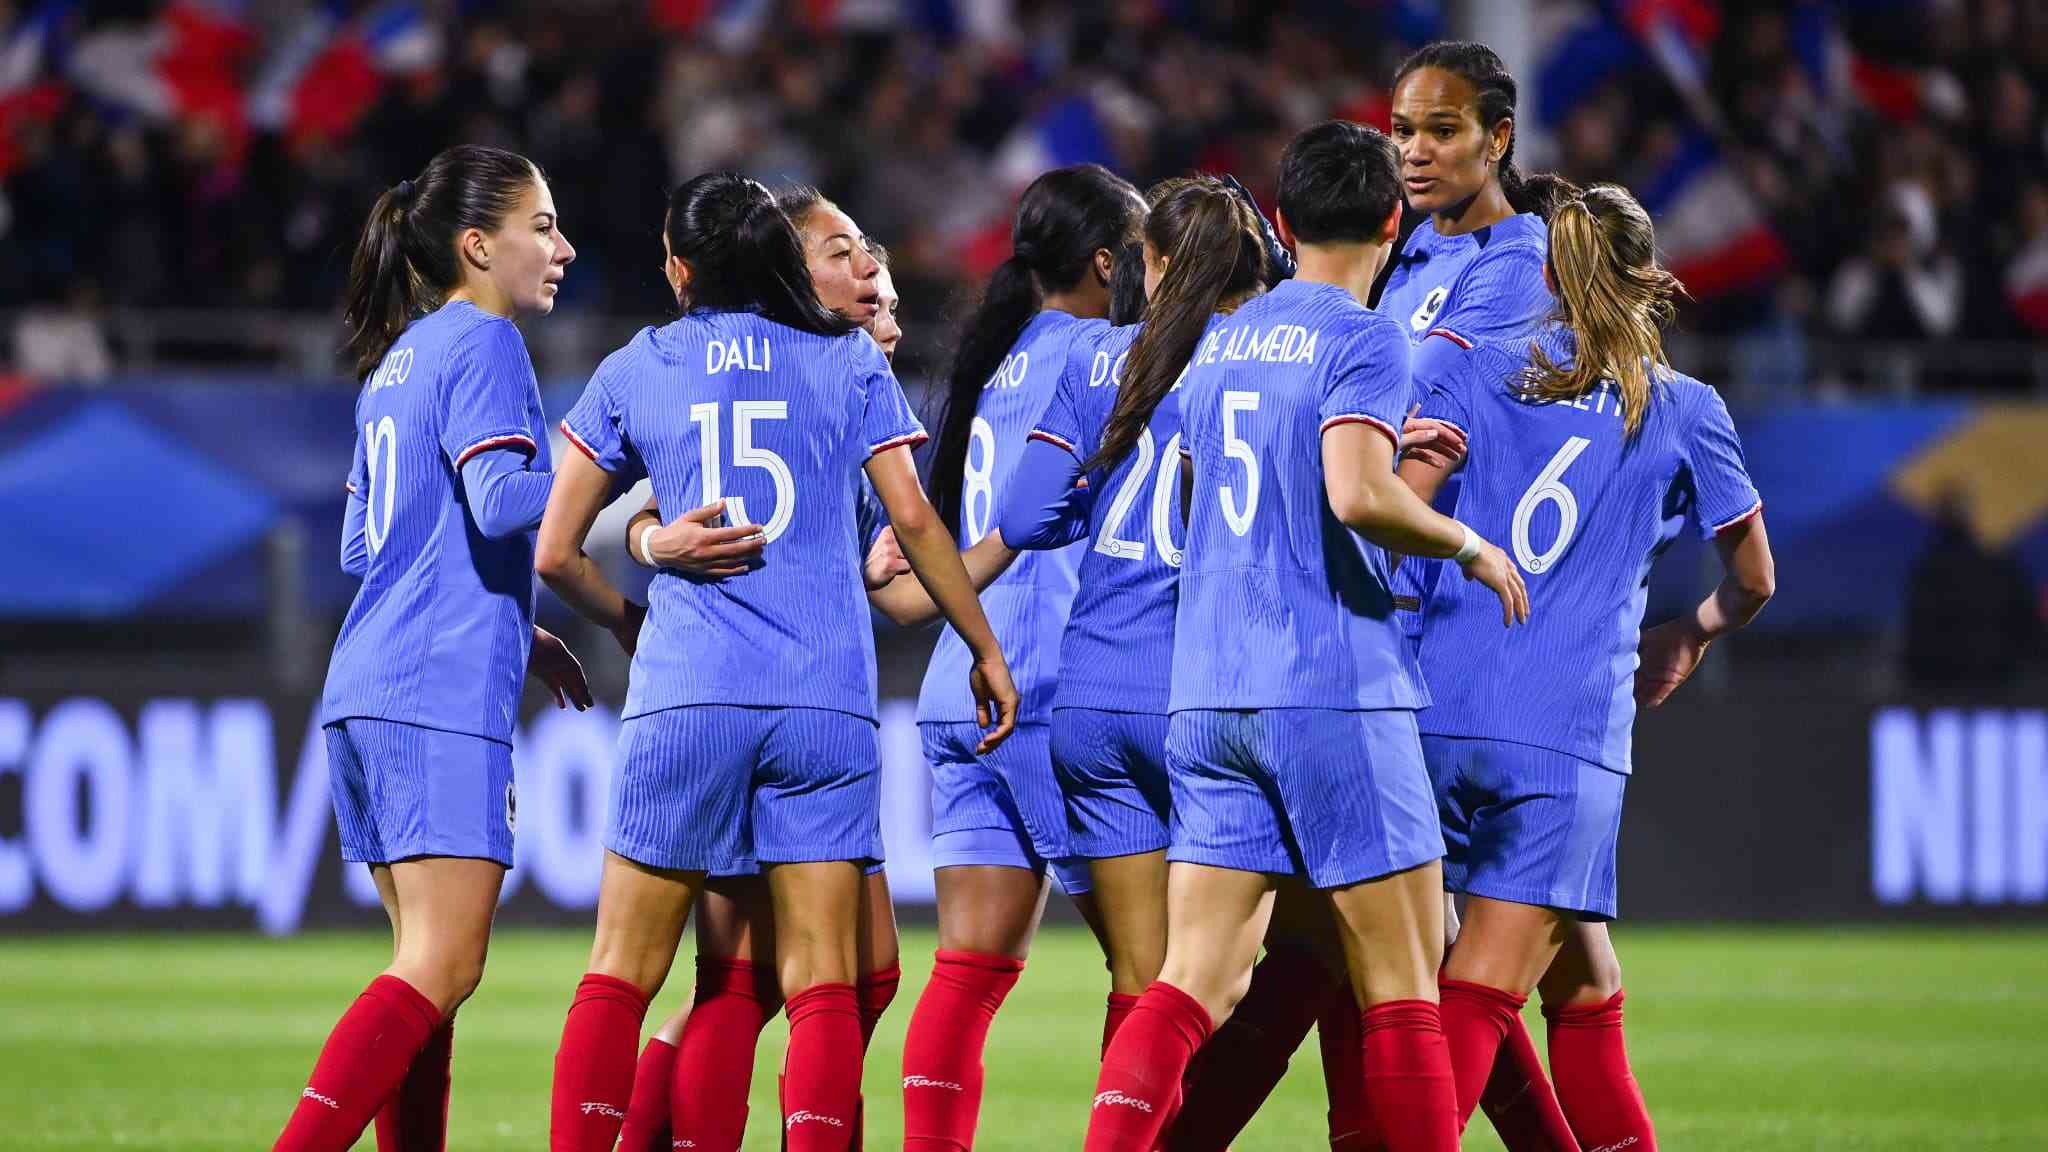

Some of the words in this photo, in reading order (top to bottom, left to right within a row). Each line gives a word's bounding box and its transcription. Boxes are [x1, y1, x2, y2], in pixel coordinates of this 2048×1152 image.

[707, 336, 771, 375] DALI
[1196, 327, 1228, 367] DE
[1219, 324, 1320, 365] ALMEIDA
[365, 415, 397, 563] 10
[690, 400, 796, 545] 15
[964, 415, 995, 546] 8
[1094, 424, 1187, 568] 20
[1219, 388, 1261, 537] 5
[1511, 435, 1592, 575] 6
[786, 1110, 844, 1131] France
[903, 1075, 963, 1091] France
[1093, 1089, 1153, 1113] France
